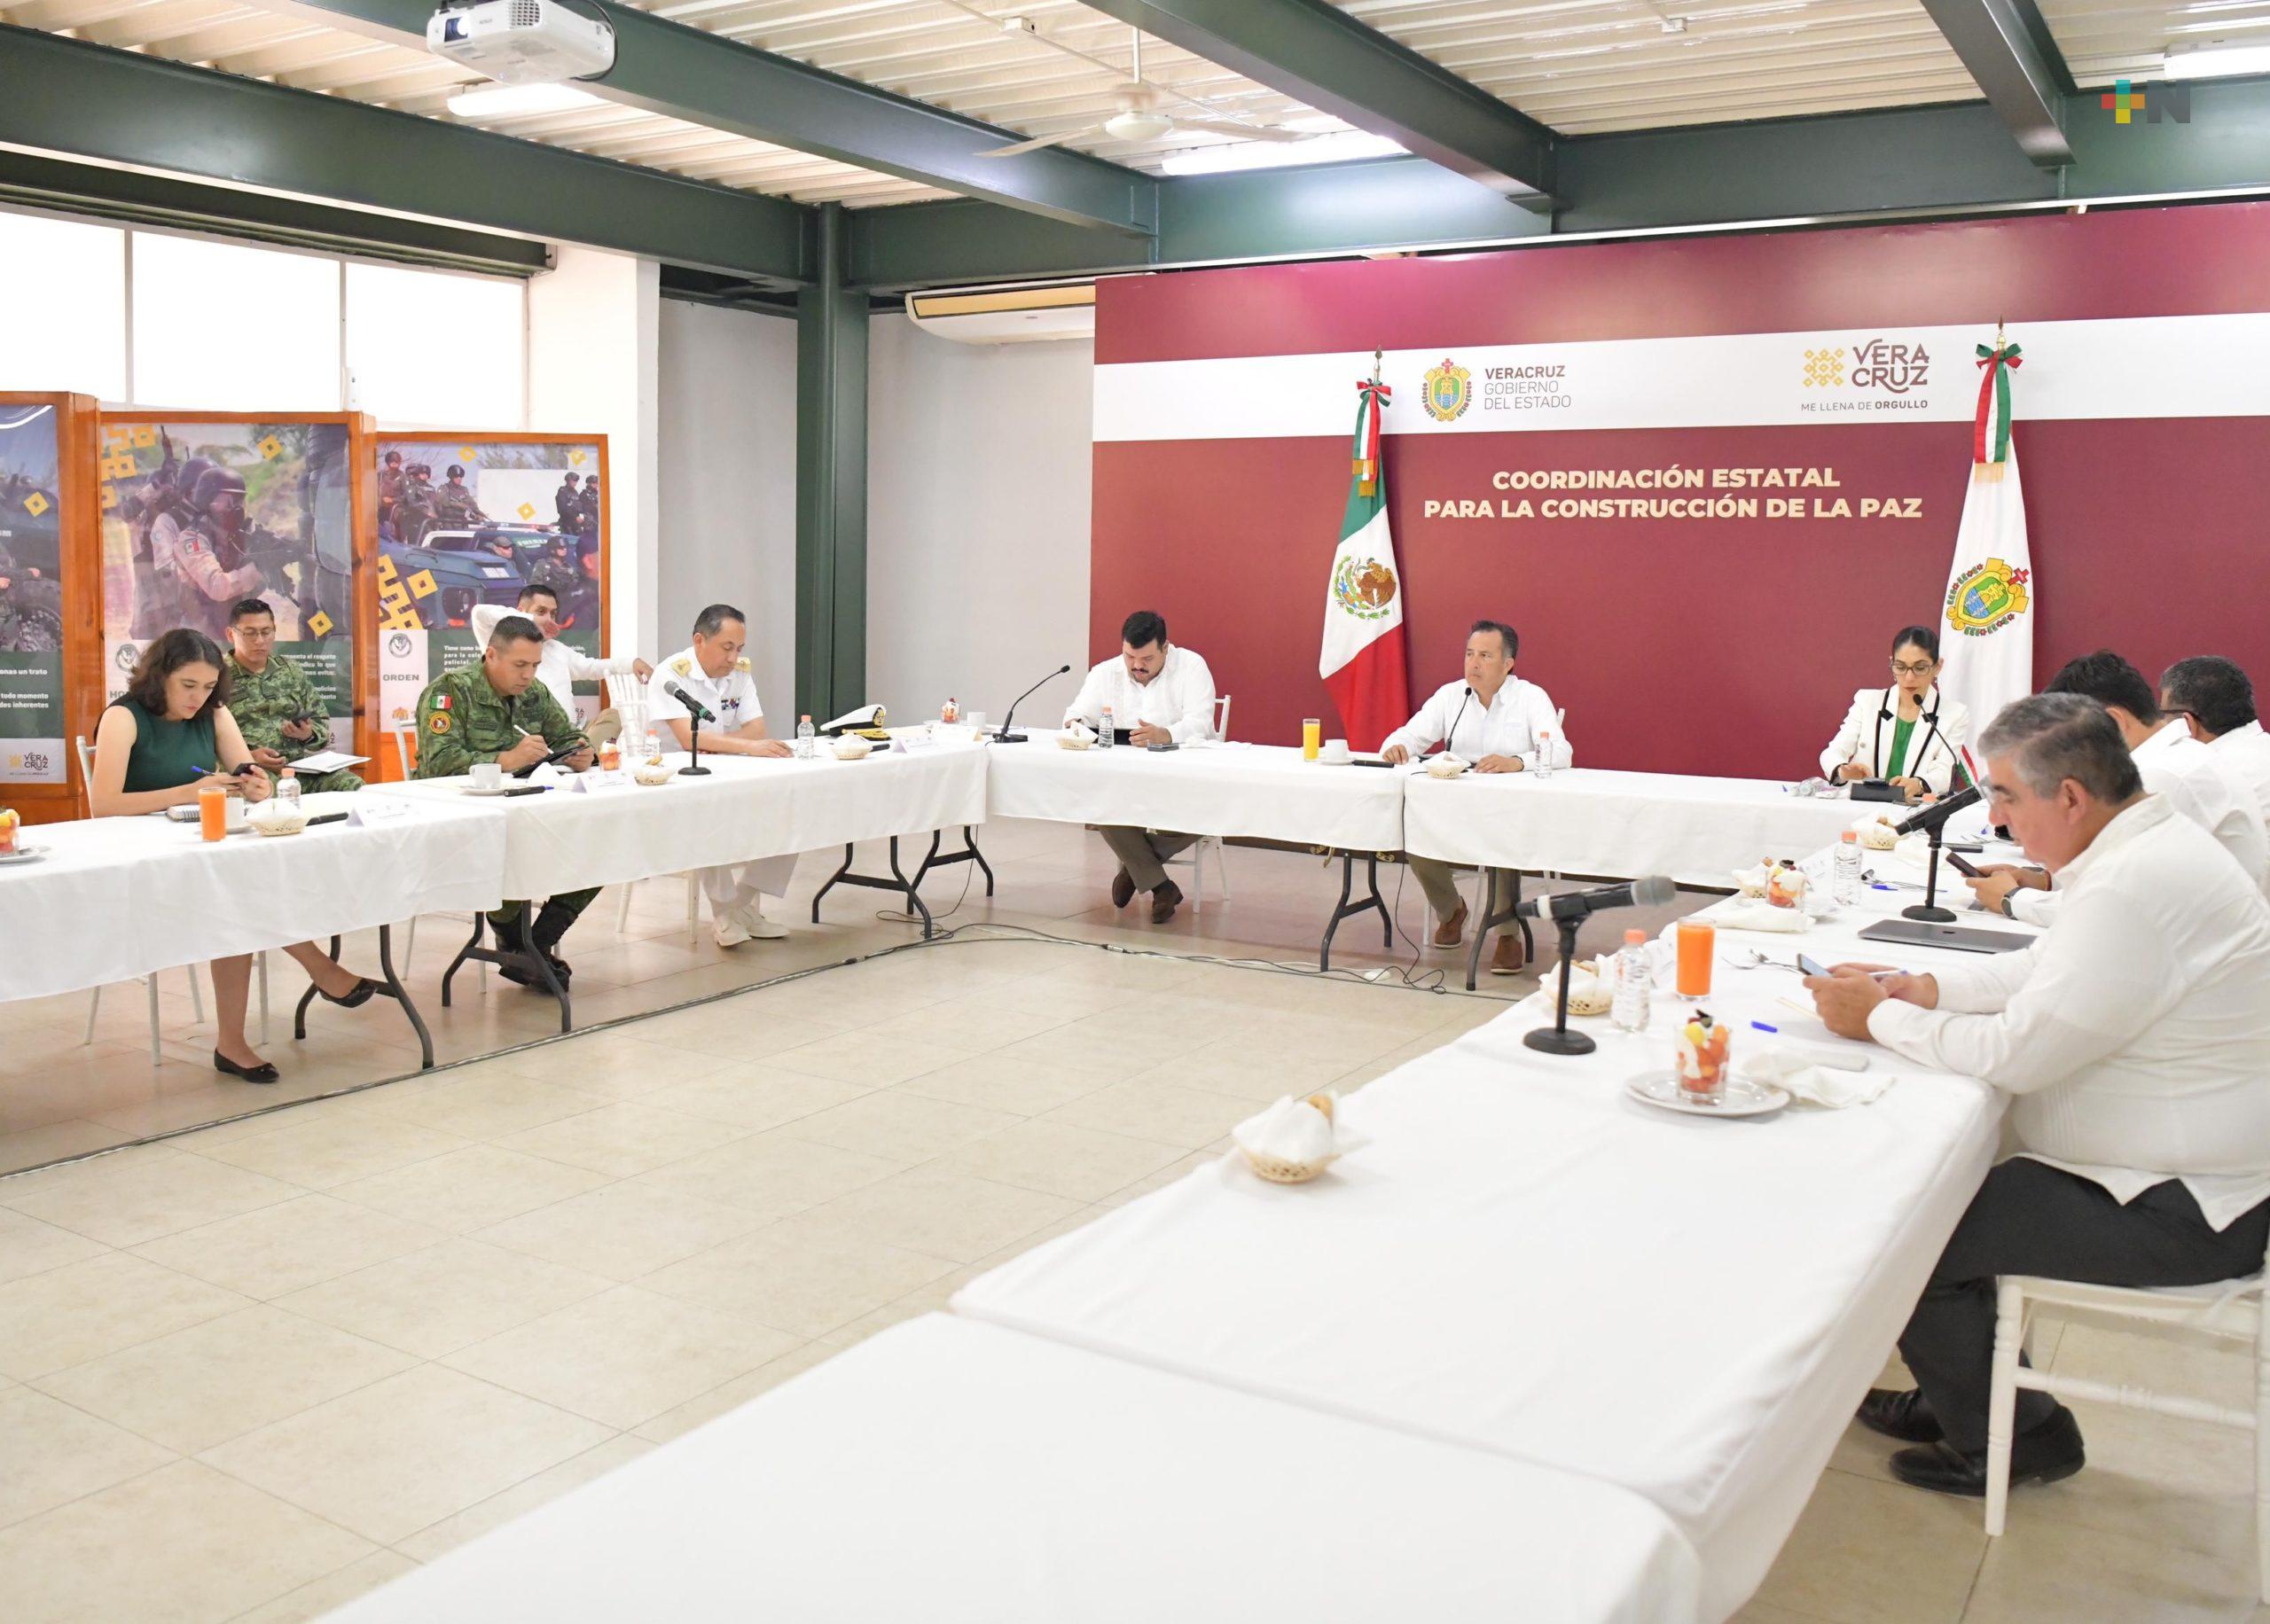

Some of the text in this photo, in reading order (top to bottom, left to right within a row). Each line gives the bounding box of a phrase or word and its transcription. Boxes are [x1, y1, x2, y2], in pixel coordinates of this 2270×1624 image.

[1852, 339, 1930, 365] VERA
[1484, 364, 1566, 379] VERACRUZ
[1851, 365, 1930, 394] CRUZ
[1484, 380, 1559, 395] GOBIERNO
[1483, 395, 1571, 410] DEL ESTADO
[1801, 399, 1929, 412] ME LLENA DE ORGULLO
[1492, 464, 1841, 489] COORDINACIÓN ESTATAL
[1424, 494, 1922, 519] PARA LA CONSTRUCCIÓN DE LA PAZ
[24, 752, 49, 761] VERA
[24, 761, 48, 771] CRUZ
